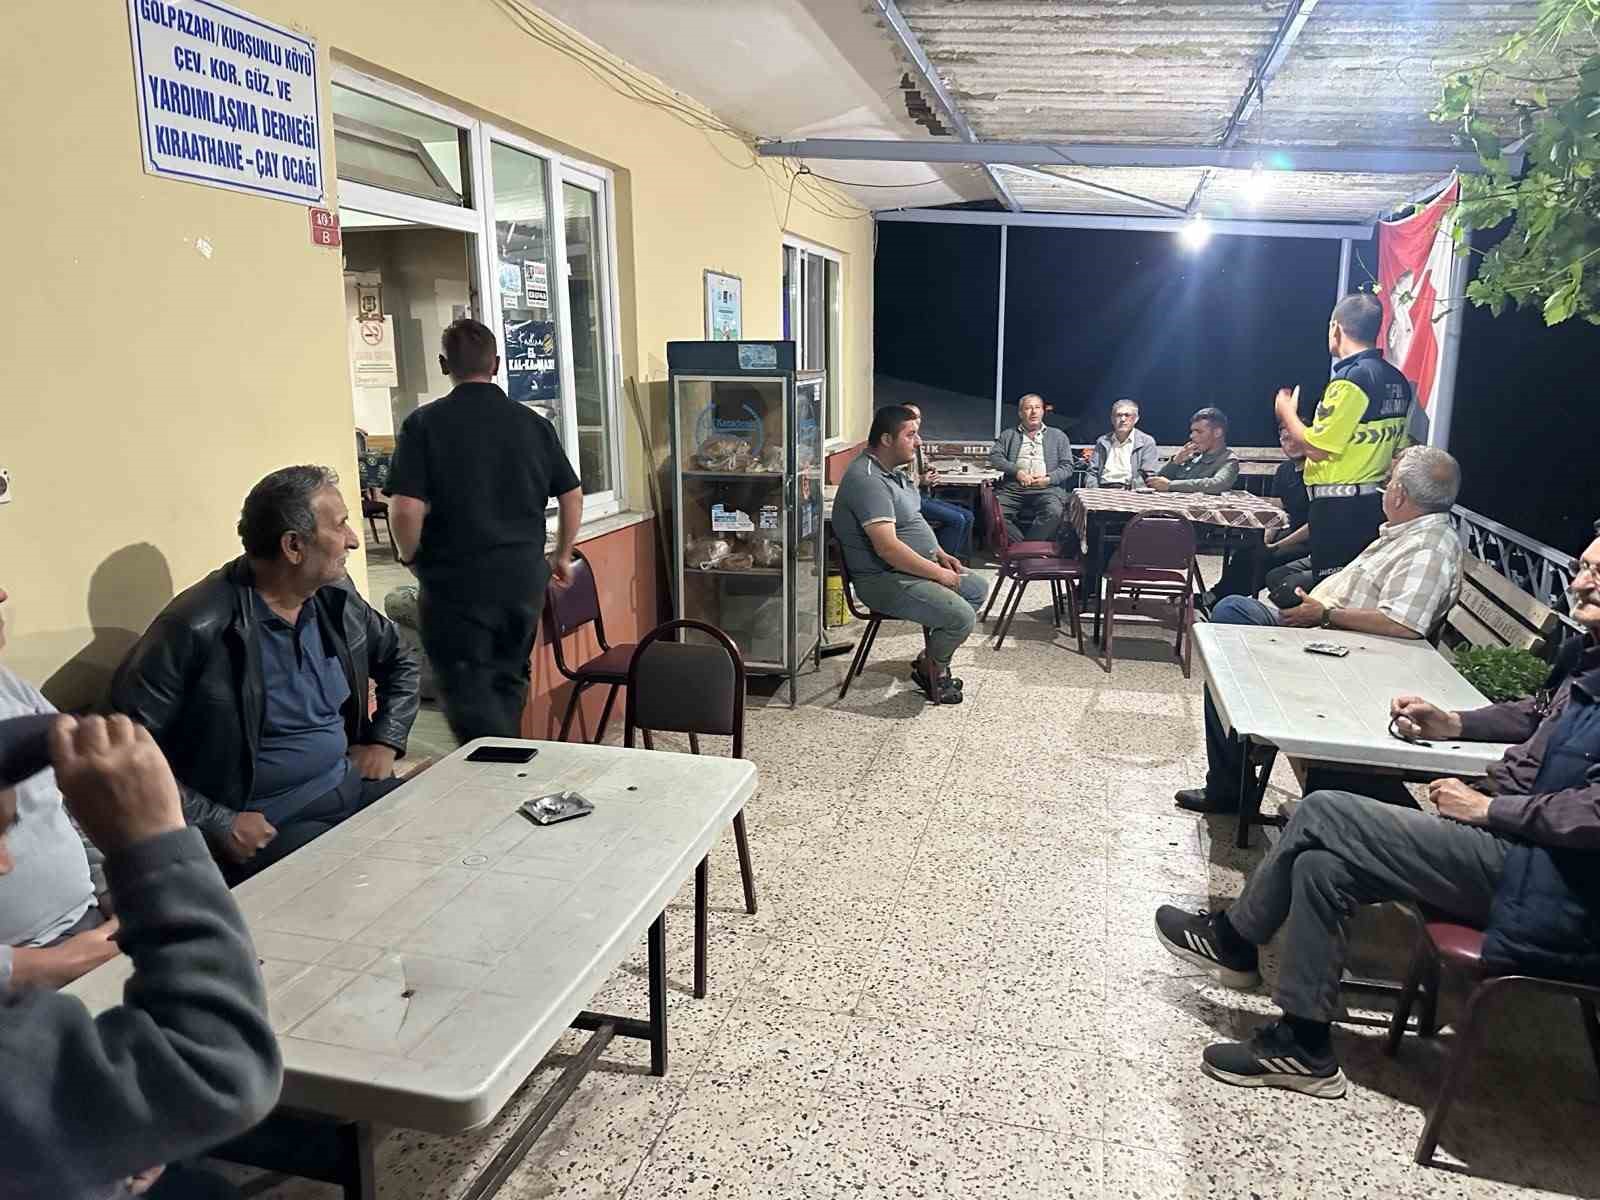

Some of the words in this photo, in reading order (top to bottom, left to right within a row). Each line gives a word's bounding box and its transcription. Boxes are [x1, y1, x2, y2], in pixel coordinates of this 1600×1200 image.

[174, 46, 206, 76] ÇEV.
[210, 57, 241, 86] KOR.
[245, 68, 274, 97] GÜZ.
[276, 79, 292, 102] VE
[285, 47, 312, 77] KÖYÜ
[149, 75, 259, 135] YARDIMLAŞMA
[262, 107, 316, 150] DERNEĞİ
[283, 156, 317, 188] OCAĞI
[322, 231, 330, 244] B
